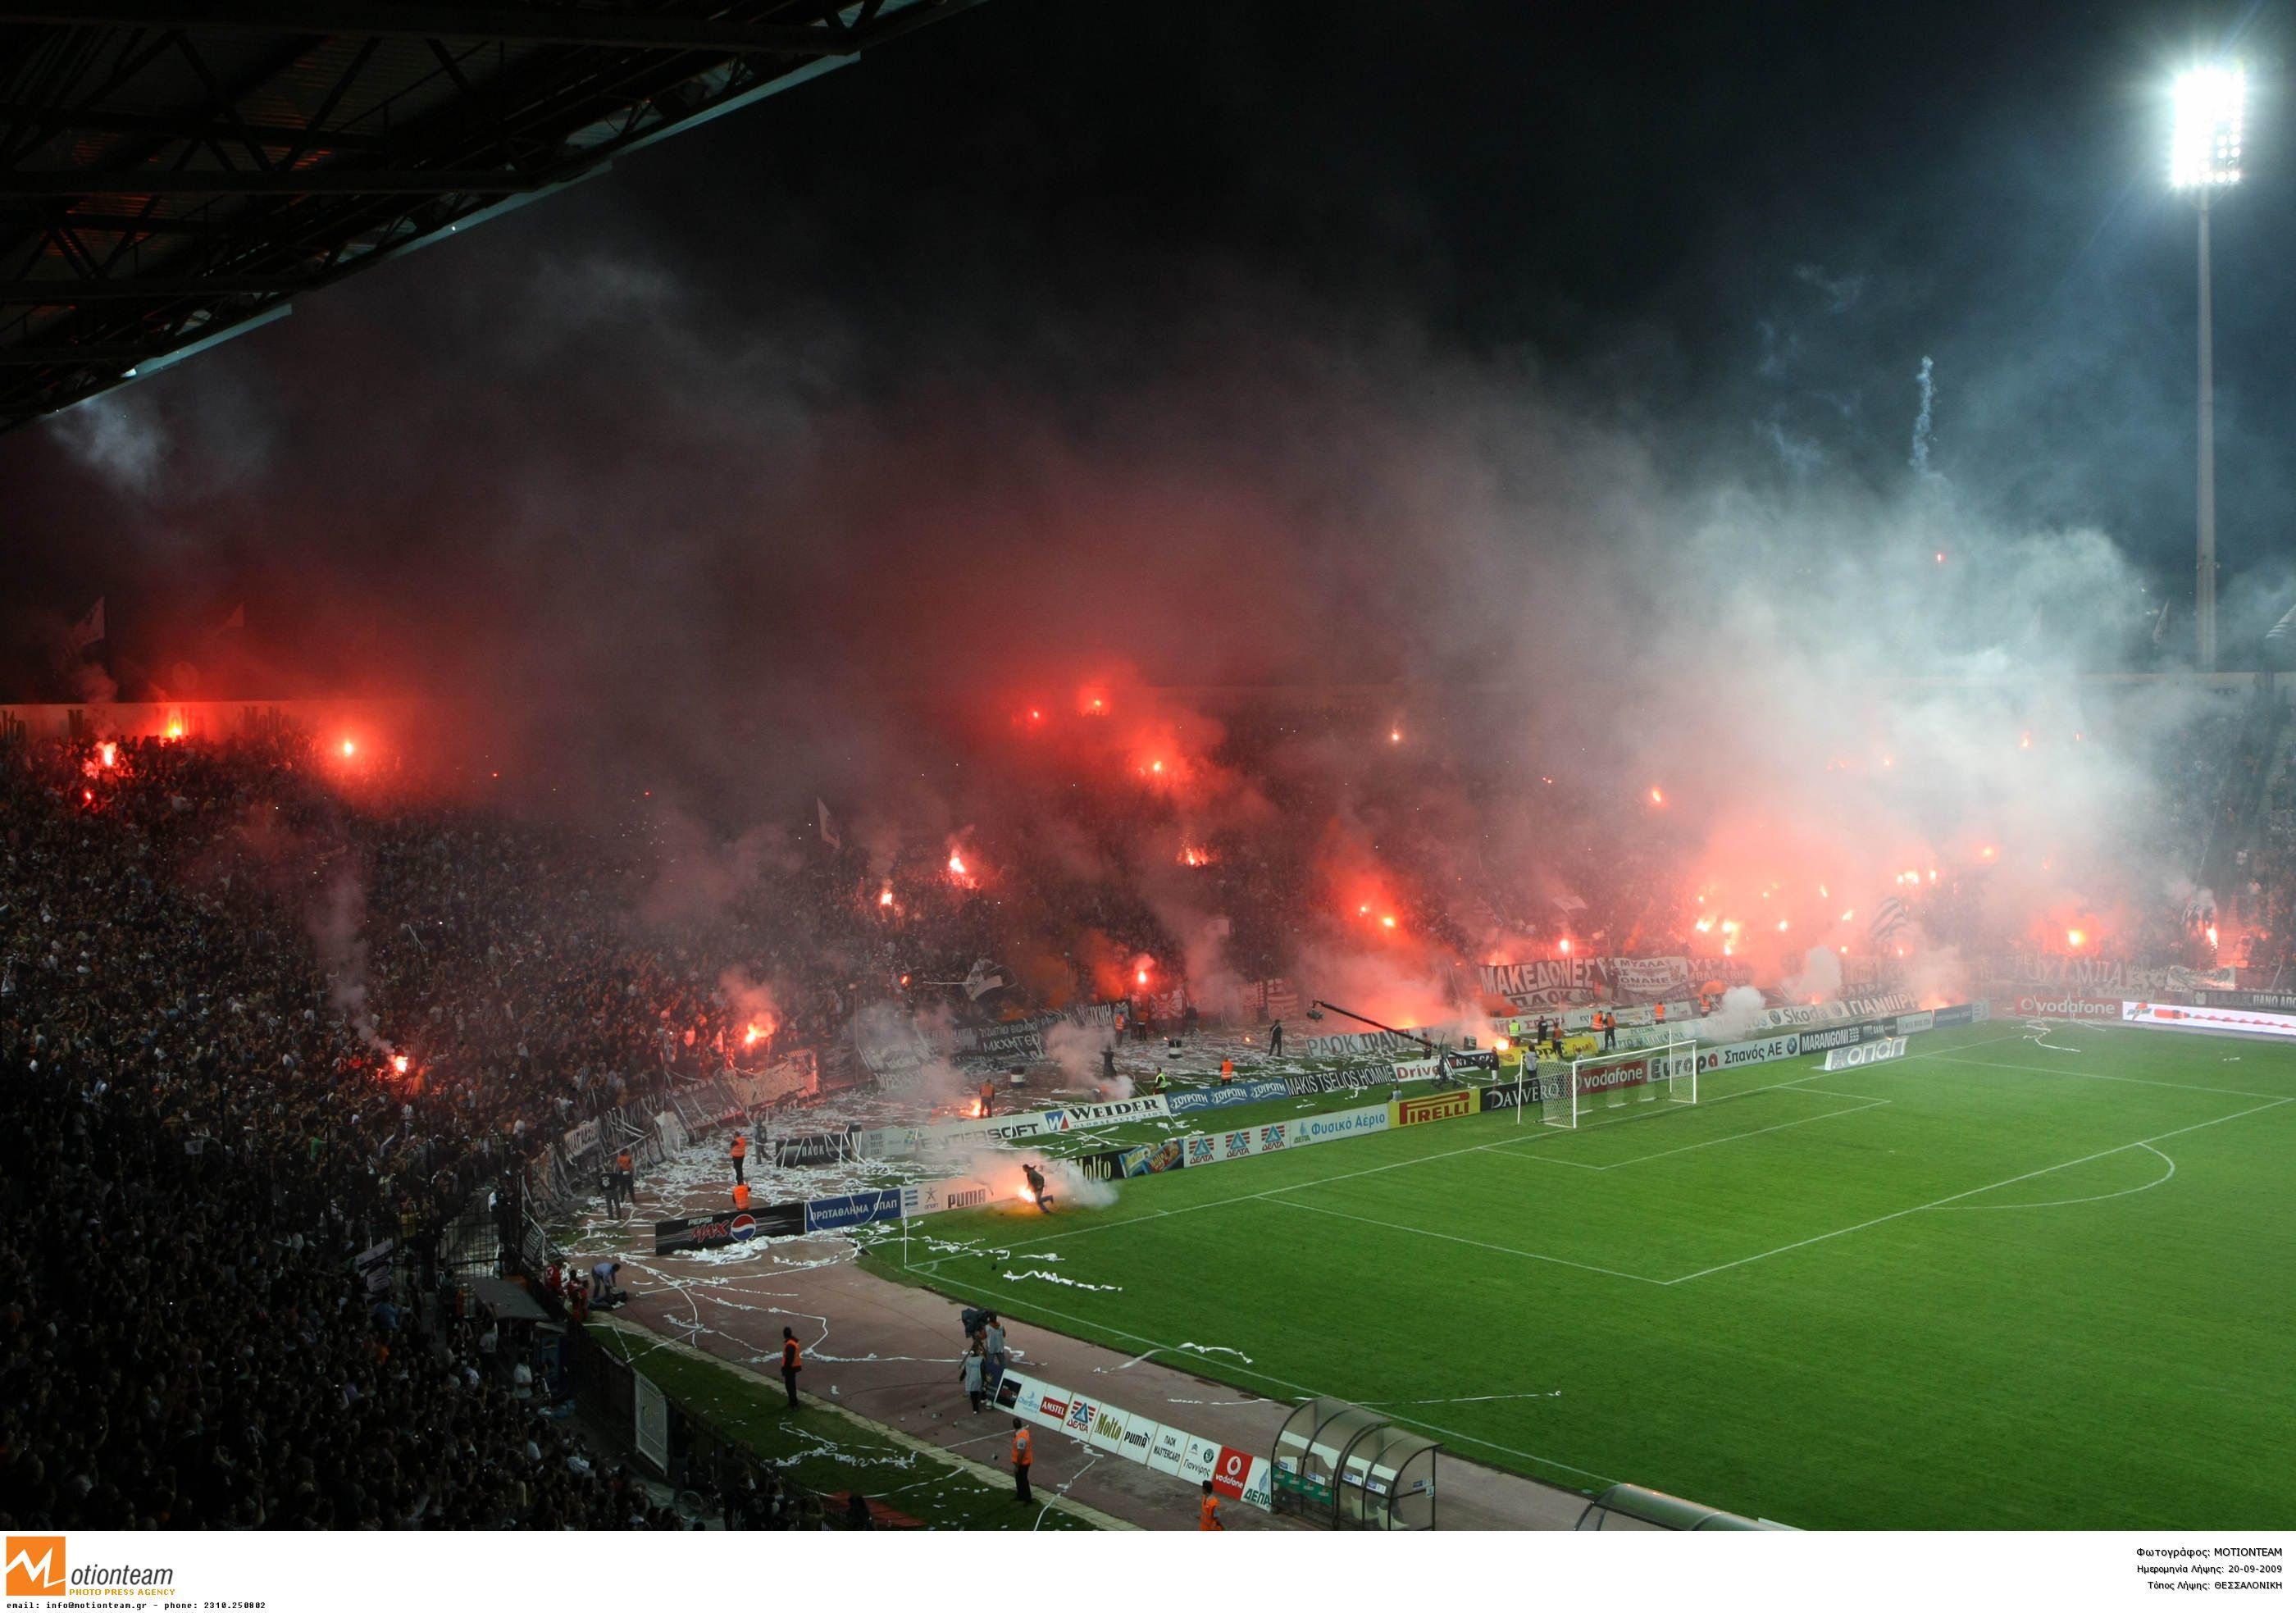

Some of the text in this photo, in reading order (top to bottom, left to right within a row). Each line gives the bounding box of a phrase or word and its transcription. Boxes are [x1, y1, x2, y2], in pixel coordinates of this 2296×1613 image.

[1784, 1007, 1827, 1024] Skoda
[2039, 1000, 2116, 1014] vodafone
[1306, 1035, 1357, 1058] PAOK
[1802, 1028, 1848, 1052] MARANGONI
[1724, 1044, 1764, 1064] Σπανός
[1288, 1064, 1396, 1096] MAKIS TSELIOS HOMME
[1583, 1068, 1643, 1088] vodafone
[1068, 1099, 1160, 1120] WEIDER
[1399, 1091, 1470, 1125] PIRELLI
[1311, 1112, 1386, 1136] Φυσικό Αέριο
[687, 1216, 713, 1226] PEPSI
[689, 1220, 730, 1242] MAX
[1042, 1401, 1064, 1415] AMSTEL
[1094, 1413, 1123, 1441] Molto
[1124, 1431, 1147, 1448] PUMA
[1215, 1473, 1243, 1489] vodafone
